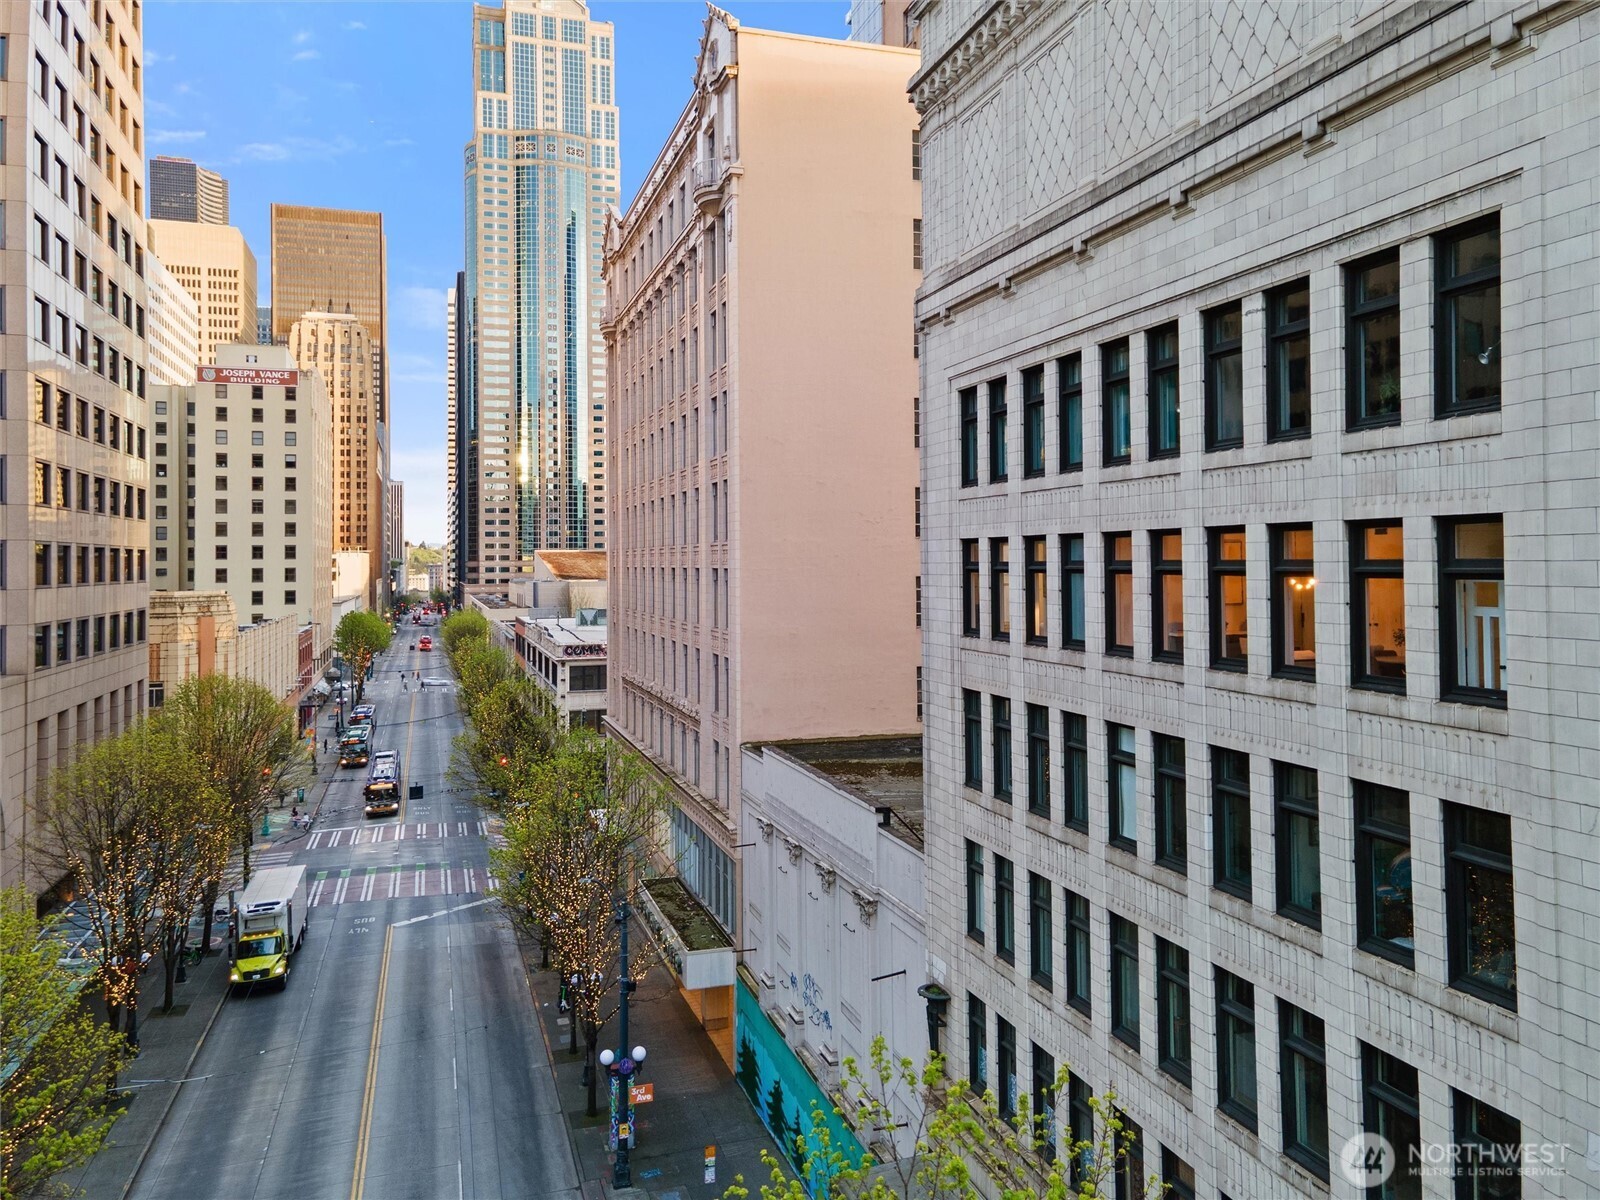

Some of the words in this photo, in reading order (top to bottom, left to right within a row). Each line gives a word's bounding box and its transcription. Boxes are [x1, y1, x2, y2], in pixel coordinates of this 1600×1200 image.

[220, 369, 256, 377] JOSEPH
[259, 370, 290, 379] VANCE
[230, 376, 280, 384] BUILDING
[631, 1086, 646, 1096] 3rd
[636, 1094, 652, 1102] Ave
